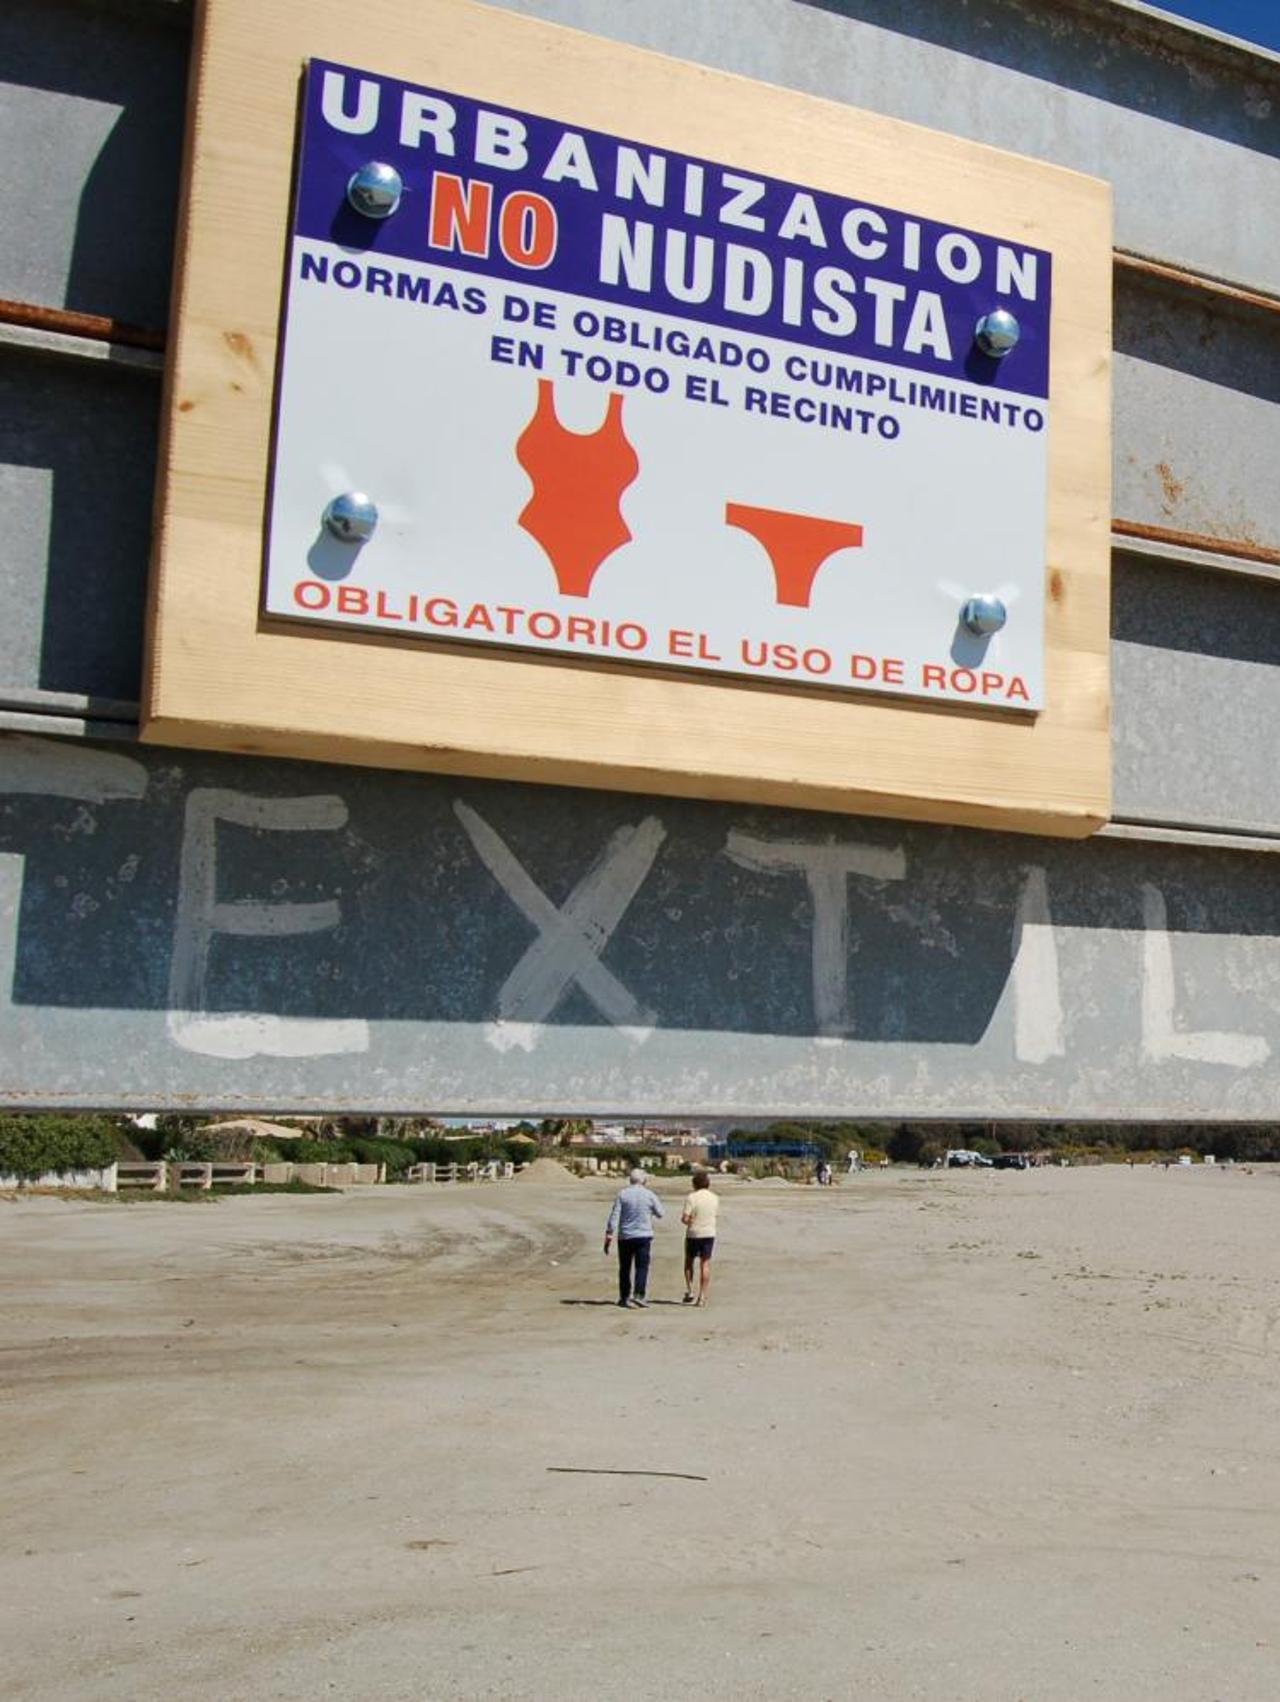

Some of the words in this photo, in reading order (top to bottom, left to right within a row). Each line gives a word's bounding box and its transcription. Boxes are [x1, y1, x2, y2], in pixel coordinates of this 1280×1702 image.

[320, 72, 1040, 301] URBANIZACION
[427, 170, 558, 270] NO
[600, 216, 952, 361] NUDISTA
[300, 252, 488, 315] NORMAS
[504, 294, 558, 329] DE
[573, 312, 771, 373] OBLIGADO
[785, 356, 1044, 433] CUMPLIMIENTO
[490, 336, 544, 370] EN
[560, 350, 670, 395] TODO
[686, 376, 730, 406] EL
[745, 387, 901, 439] RECINTO
[292, 580, 648, 651] OBLIGATORIO
[668, 631, 722, 662] EL
[740, 641, 832, 675] USO
[850, 656, 904, 684] DE
[922, 666, 1030, 701] ROPA
